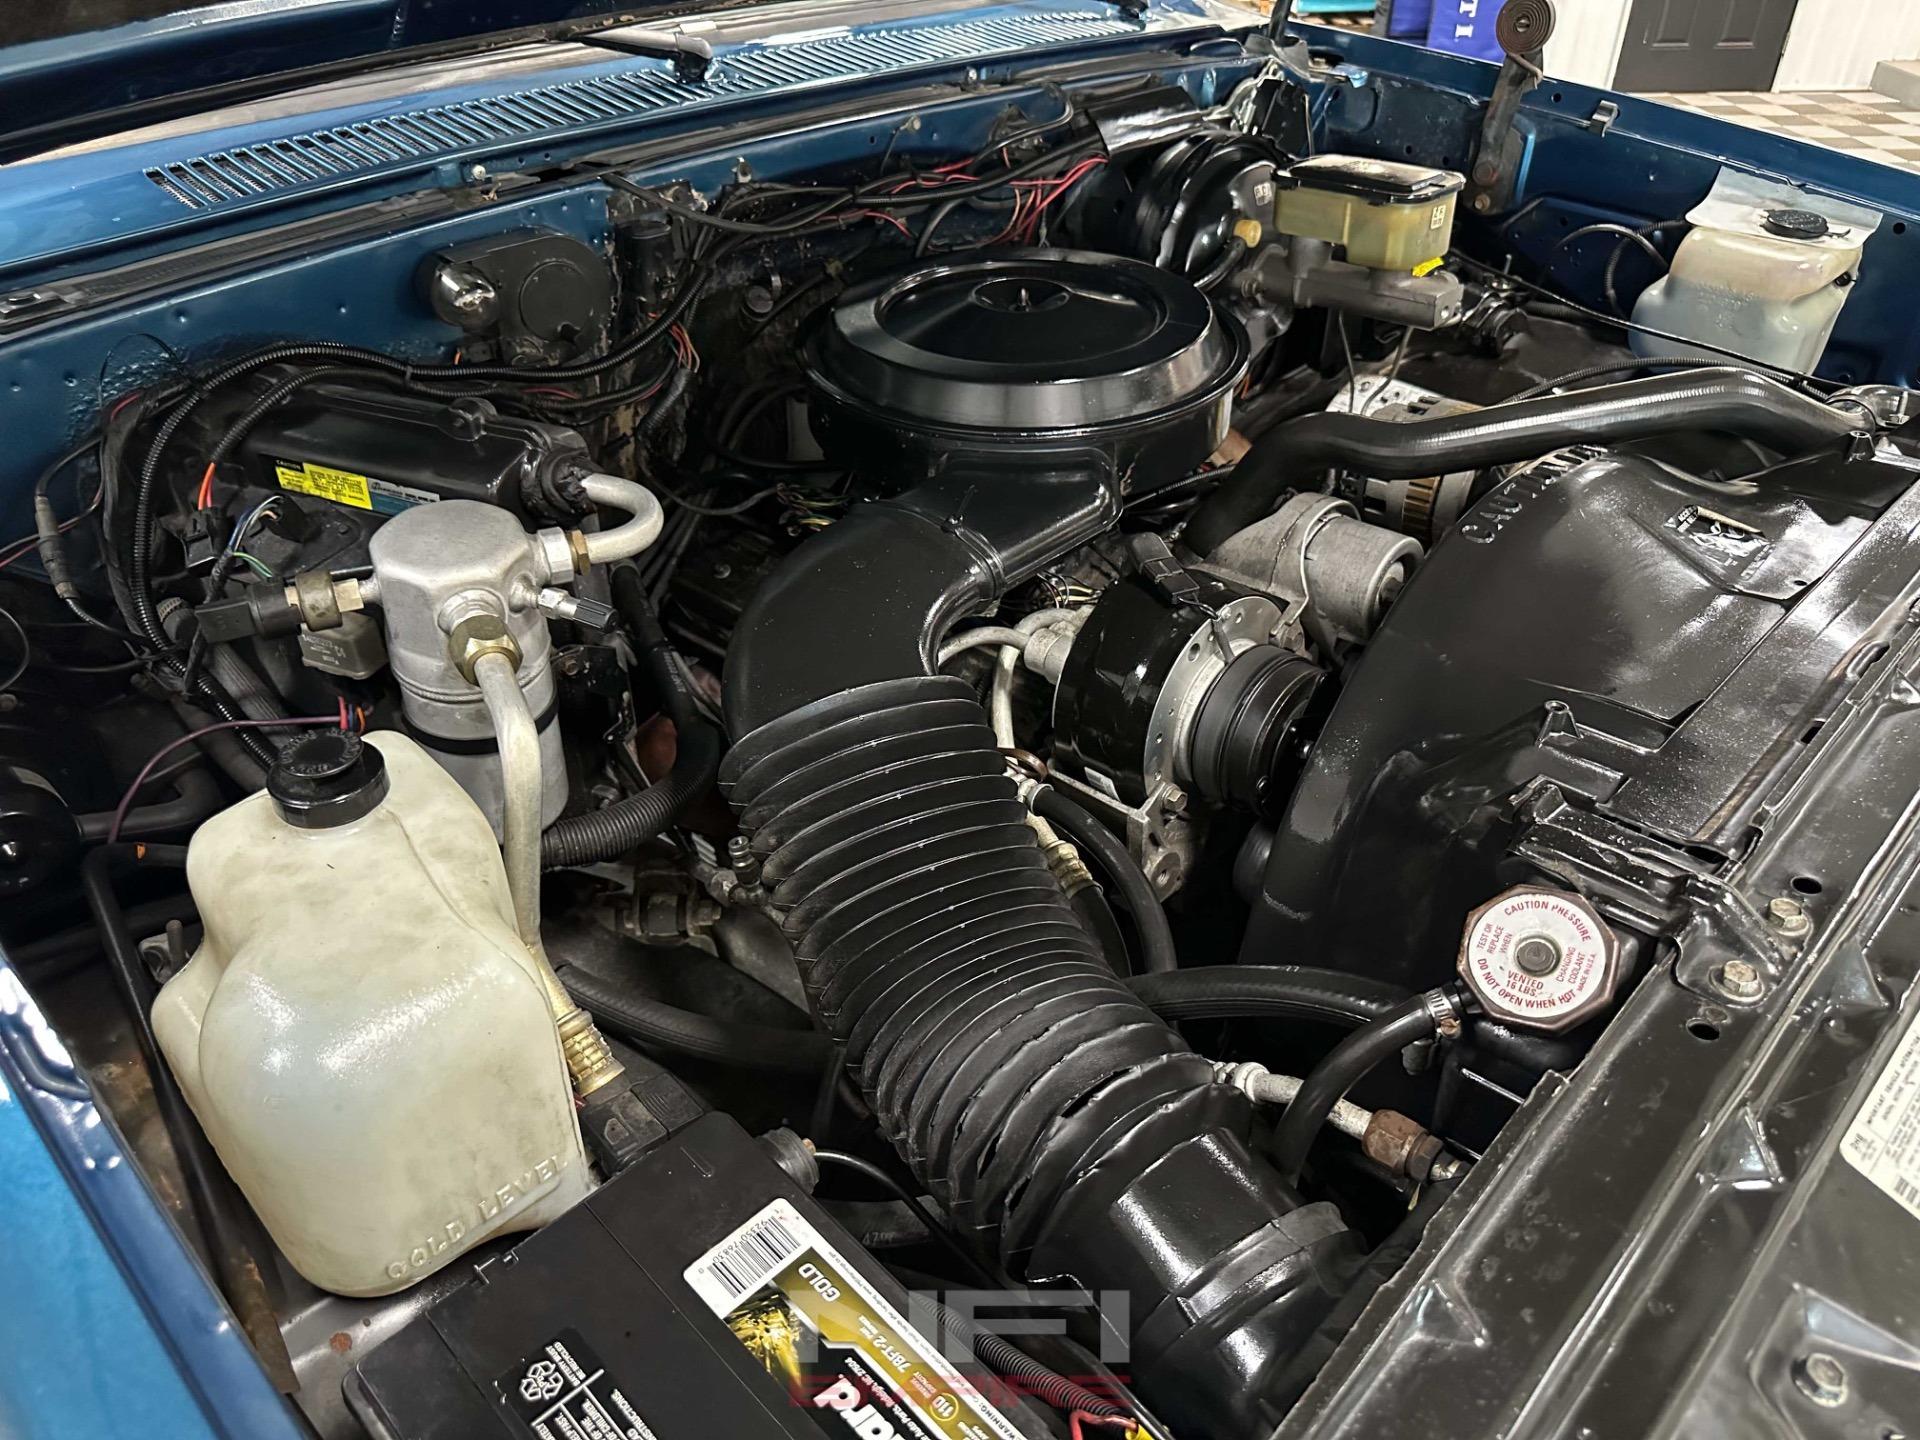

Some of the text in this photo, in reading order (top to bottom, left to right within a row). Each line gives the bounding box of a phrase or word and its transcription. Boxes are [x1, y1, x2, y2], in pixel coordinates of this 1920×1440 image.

[1477, 923, 1492, 949] TEST OR
[1504, 900, 1591, 942] CAUTION PRESSURE
[1486, 925, 1504, 954] REPLACE
[1500, 933, 1513, 954] WHEN
[1555, 945, 1575, 982] CHANGING
[1567, 951, 1586, 984] COOLANT
[1477, 958, 1576, 1009] DO NOT OPEN WHEN HOT
[1506, 979, 1538, 998] 16 LBS.
[1507, 970, 1544, 990] VENTED
[1578, 975, 1588, 991] MADE
[387, 1155, 568, 1279] COLD LEVEL
[741, 1219, 767, 1241] 92350
[712, 1240, 739, 1264] 76830
[798, 1262, 841, 1302] GOLD
[545, 1345, 580, 1387] BATTERY MUST
[553, 1341, 586, 1380] BE RECYCLED
[873, 1336, 912, 1373] 78FT-2
[932, 1396, 954, 1417] 110
[978, 1403, 1016, 1440] WARNING:
[906, 1419, 924, 1437] Auto
